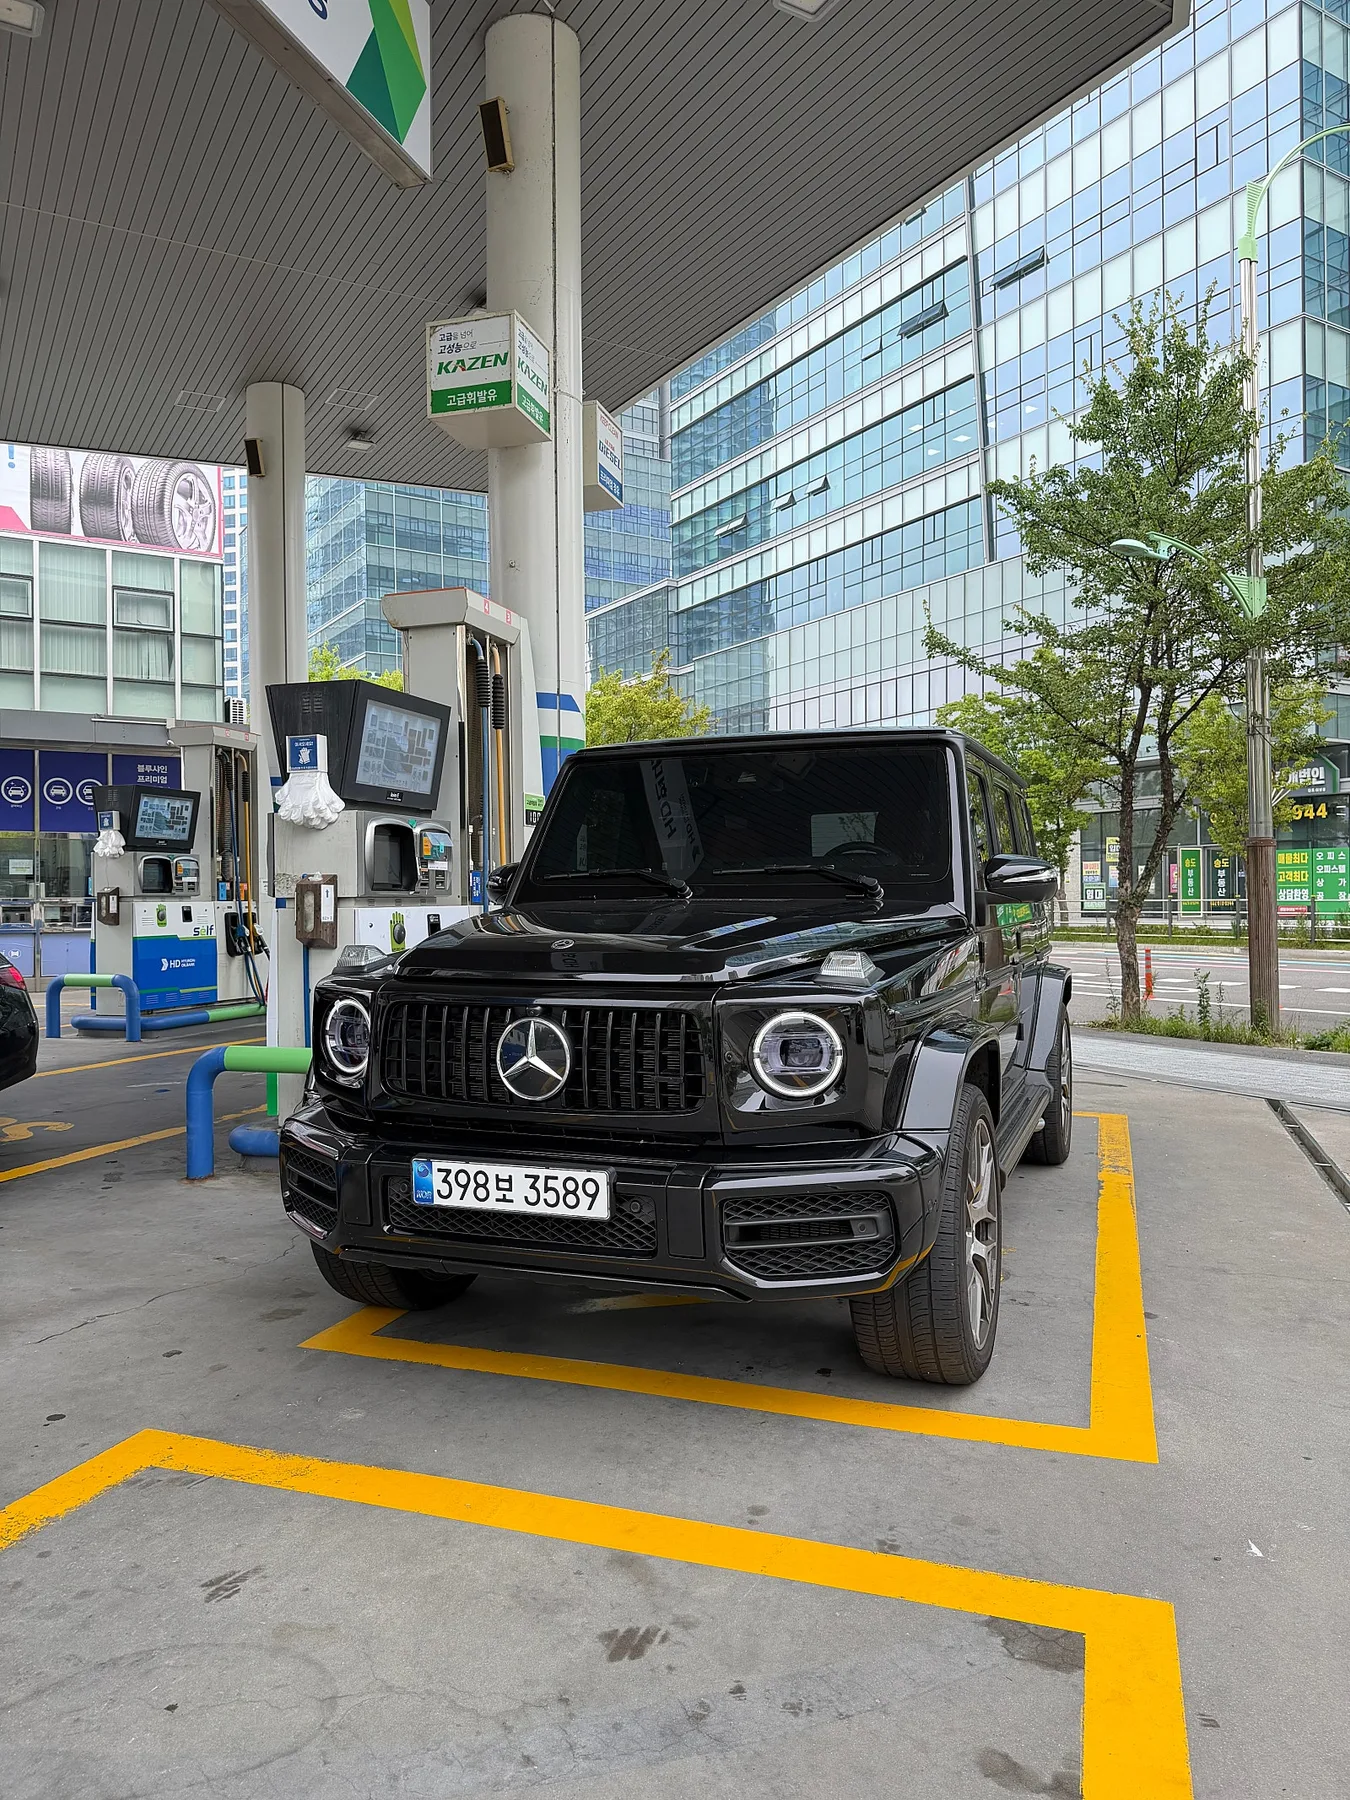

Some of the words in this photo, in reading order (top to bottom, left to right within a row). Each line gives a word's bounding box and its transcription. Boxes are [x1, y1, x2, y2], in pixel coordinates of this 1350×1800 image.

[437, 350, 509, 375] KAZEN
[517, 355, 548, 396] KAZEN
[446, 388, 498, 407] 고급휘발유
[599, 439, 621, 470] DIESEL
[137, 775, 168, 784] 프리미엄
[1185, 858, 1196, 868] 송도
[1213, 858, 1230, 868] 송도
[1217, 869, 1226, 897] 부동산
[1278, 870, 1309, 882] 고객최다
[170, 959, 181, 968] HD
[436, 1168, 514, 1204] 398보
[523, 1173, 600, 1211] 3589
